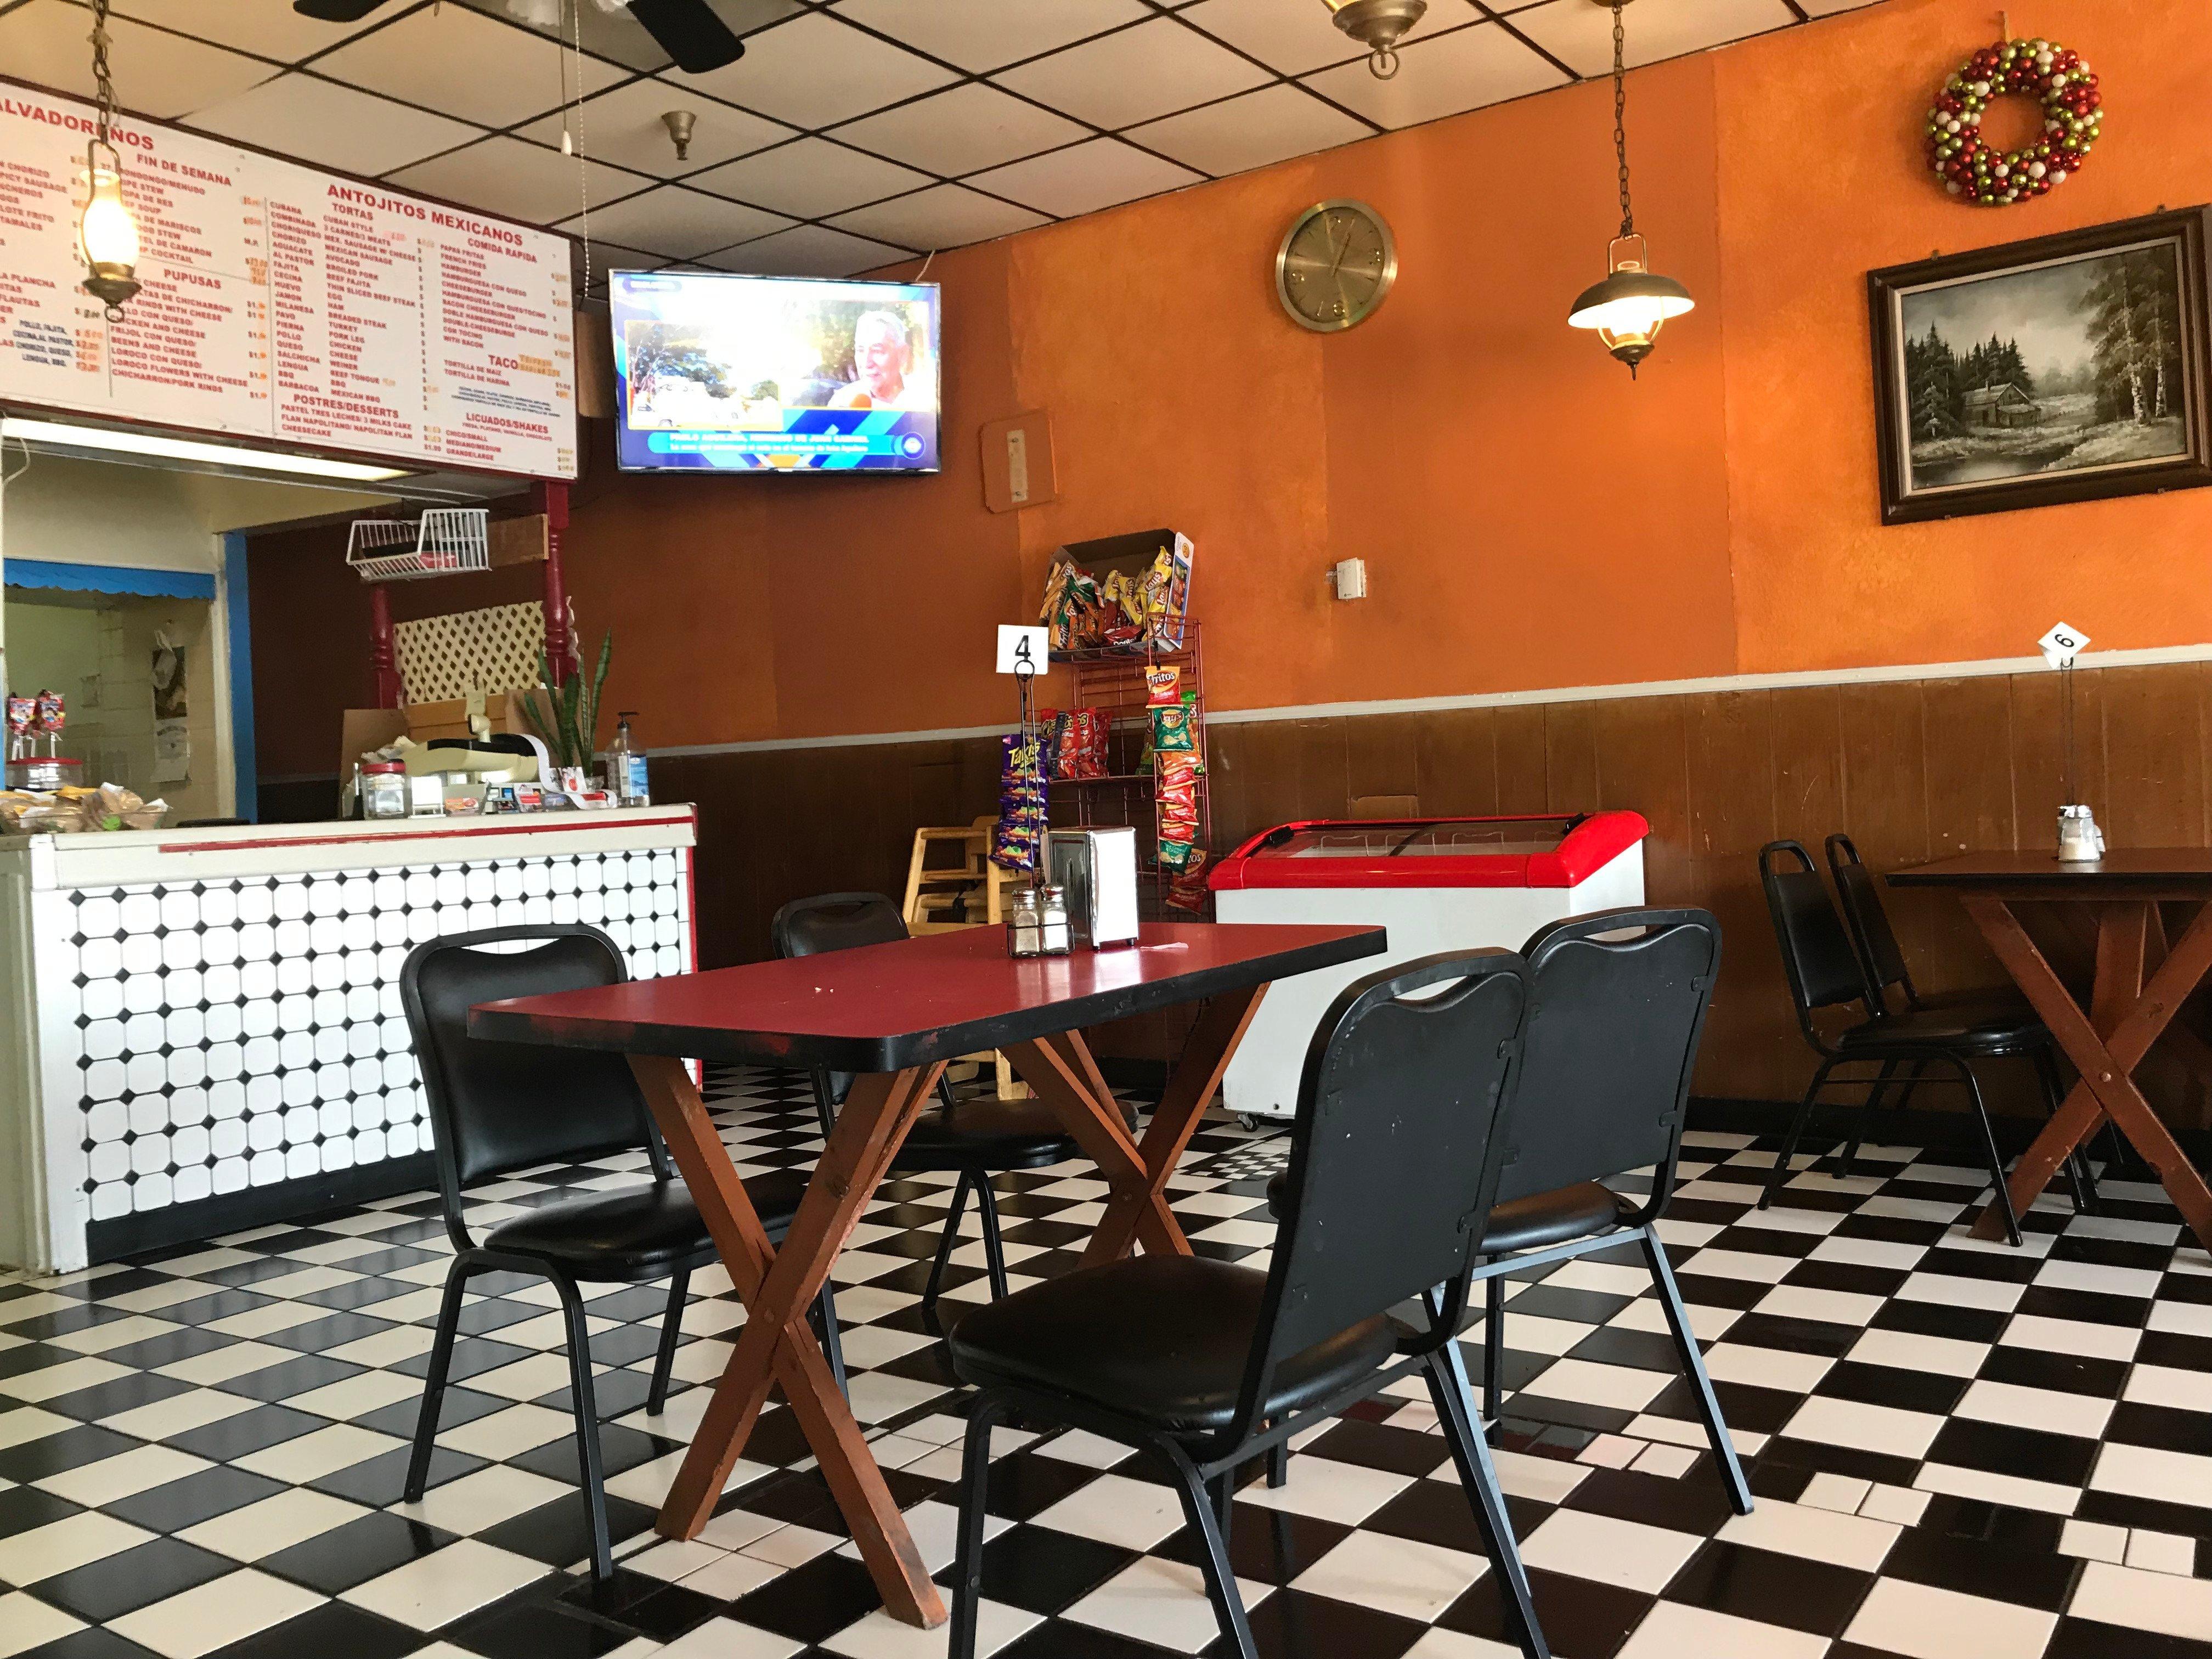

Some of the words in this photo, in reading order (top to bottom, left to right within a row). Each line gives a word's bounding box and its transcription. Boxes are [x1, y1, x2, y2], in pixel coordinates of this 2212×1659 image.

[136, 152, 158, 168] FIN
[161, 159, 177, 173] DE
[180, 164, 232, 187] SEMANA
[326, 181, 426, 222] ANTOJITOS
[431, 210, 523, 247] MEXICANOS
[331, 201, 374, 222] TORTAS
[467, 236, 504, 255] COMIDA
[504, 246, 537, 263] RAPIDA
[163, 268, 222, 290] PUPUSAS
[488, 354, 518, 370] TACO
[1015, 635, 1030, 660] 4
[1148, 672, 1176, 684] Fritos
[1008, 742, 1041, 768] Takis
